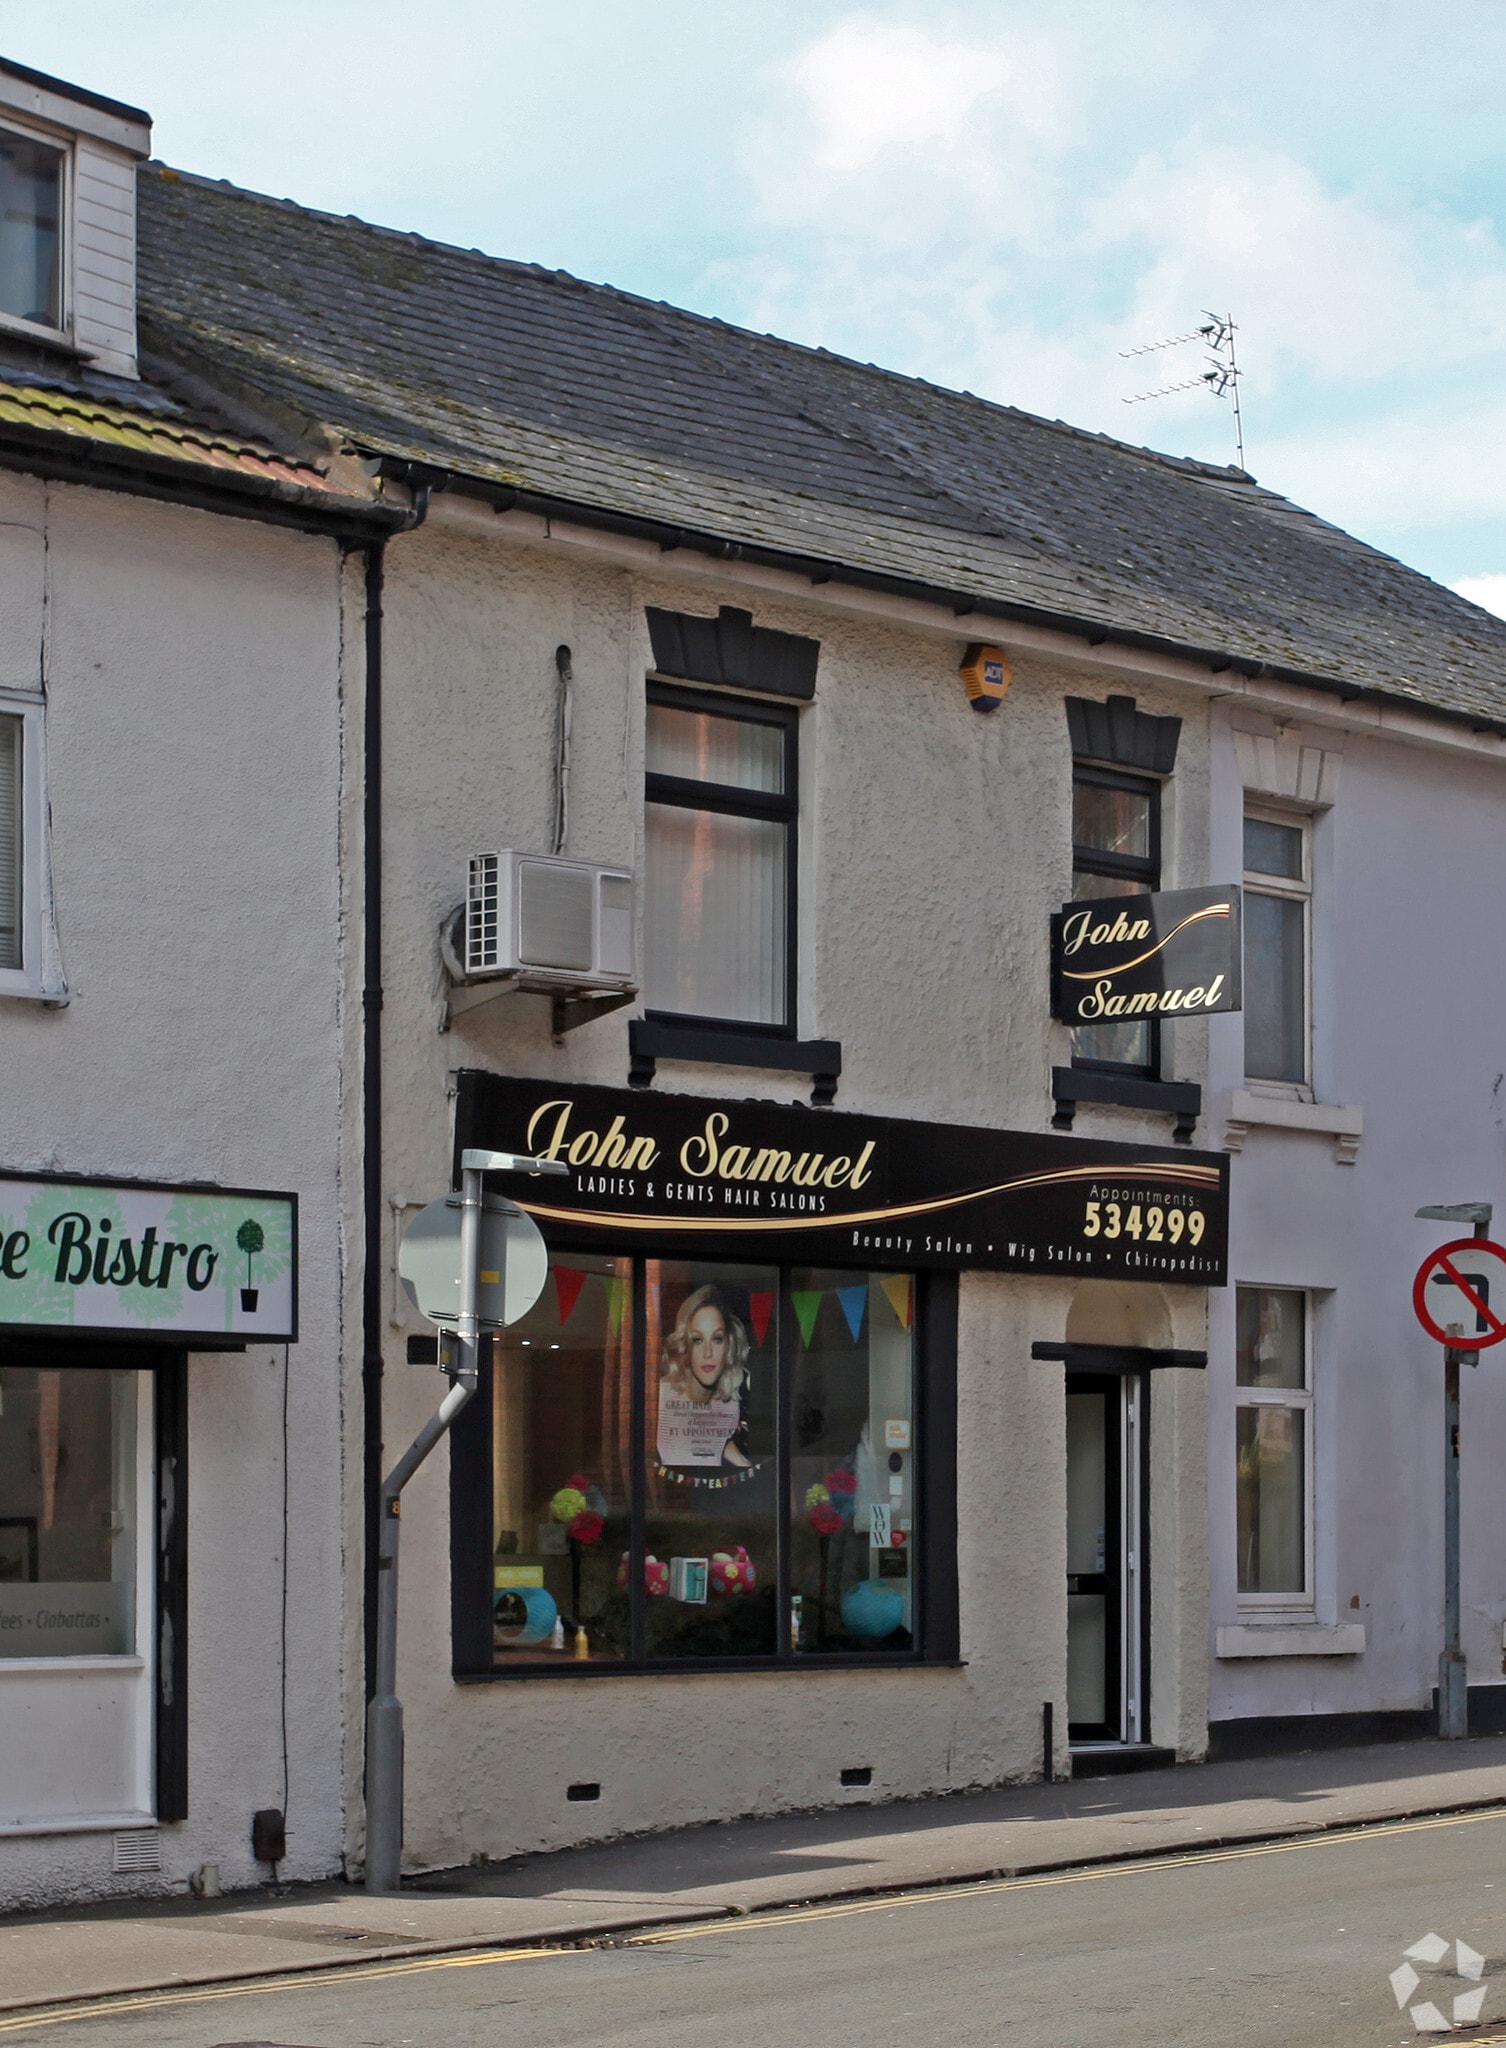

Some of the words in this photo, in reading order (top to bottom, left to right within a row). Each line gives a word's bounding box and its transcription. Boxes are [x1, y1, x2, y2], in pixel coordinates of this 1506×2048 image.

[1063, 911, 1152, 955] John
[1078, 974, 1224, 1018] Samuel
[527, 1100, 661, 1176] John
[680, 1112, 876, 1190] Samuel
[578, 1175, 635, 1196] LADIES
[646, 1183, 655, 1198] &
[665, 1183, 714, 1202] GENTS
[725, 1188, 760, 1207] HAIR
[770, 1192, 826, 1212] SALONS
[1083, 1202, 1206, 1246] 534299
[47, 1212, 219, 1291] Bistro
[852, 1231, 912, 1253] Beauty
[925, 1236, 973, 1254] Salon
[1008, 1242, 1035, 1261] Wig
[1048, 1245, 1092, 1263] Salon
[1125, 1251, 1220, 1272] Chiropodist
[658, 1466, 701, 1487] HAPPY
[708, 1467, 755, 1489] EASTER
[36, 1609, 101, 1629] Ciabattas
